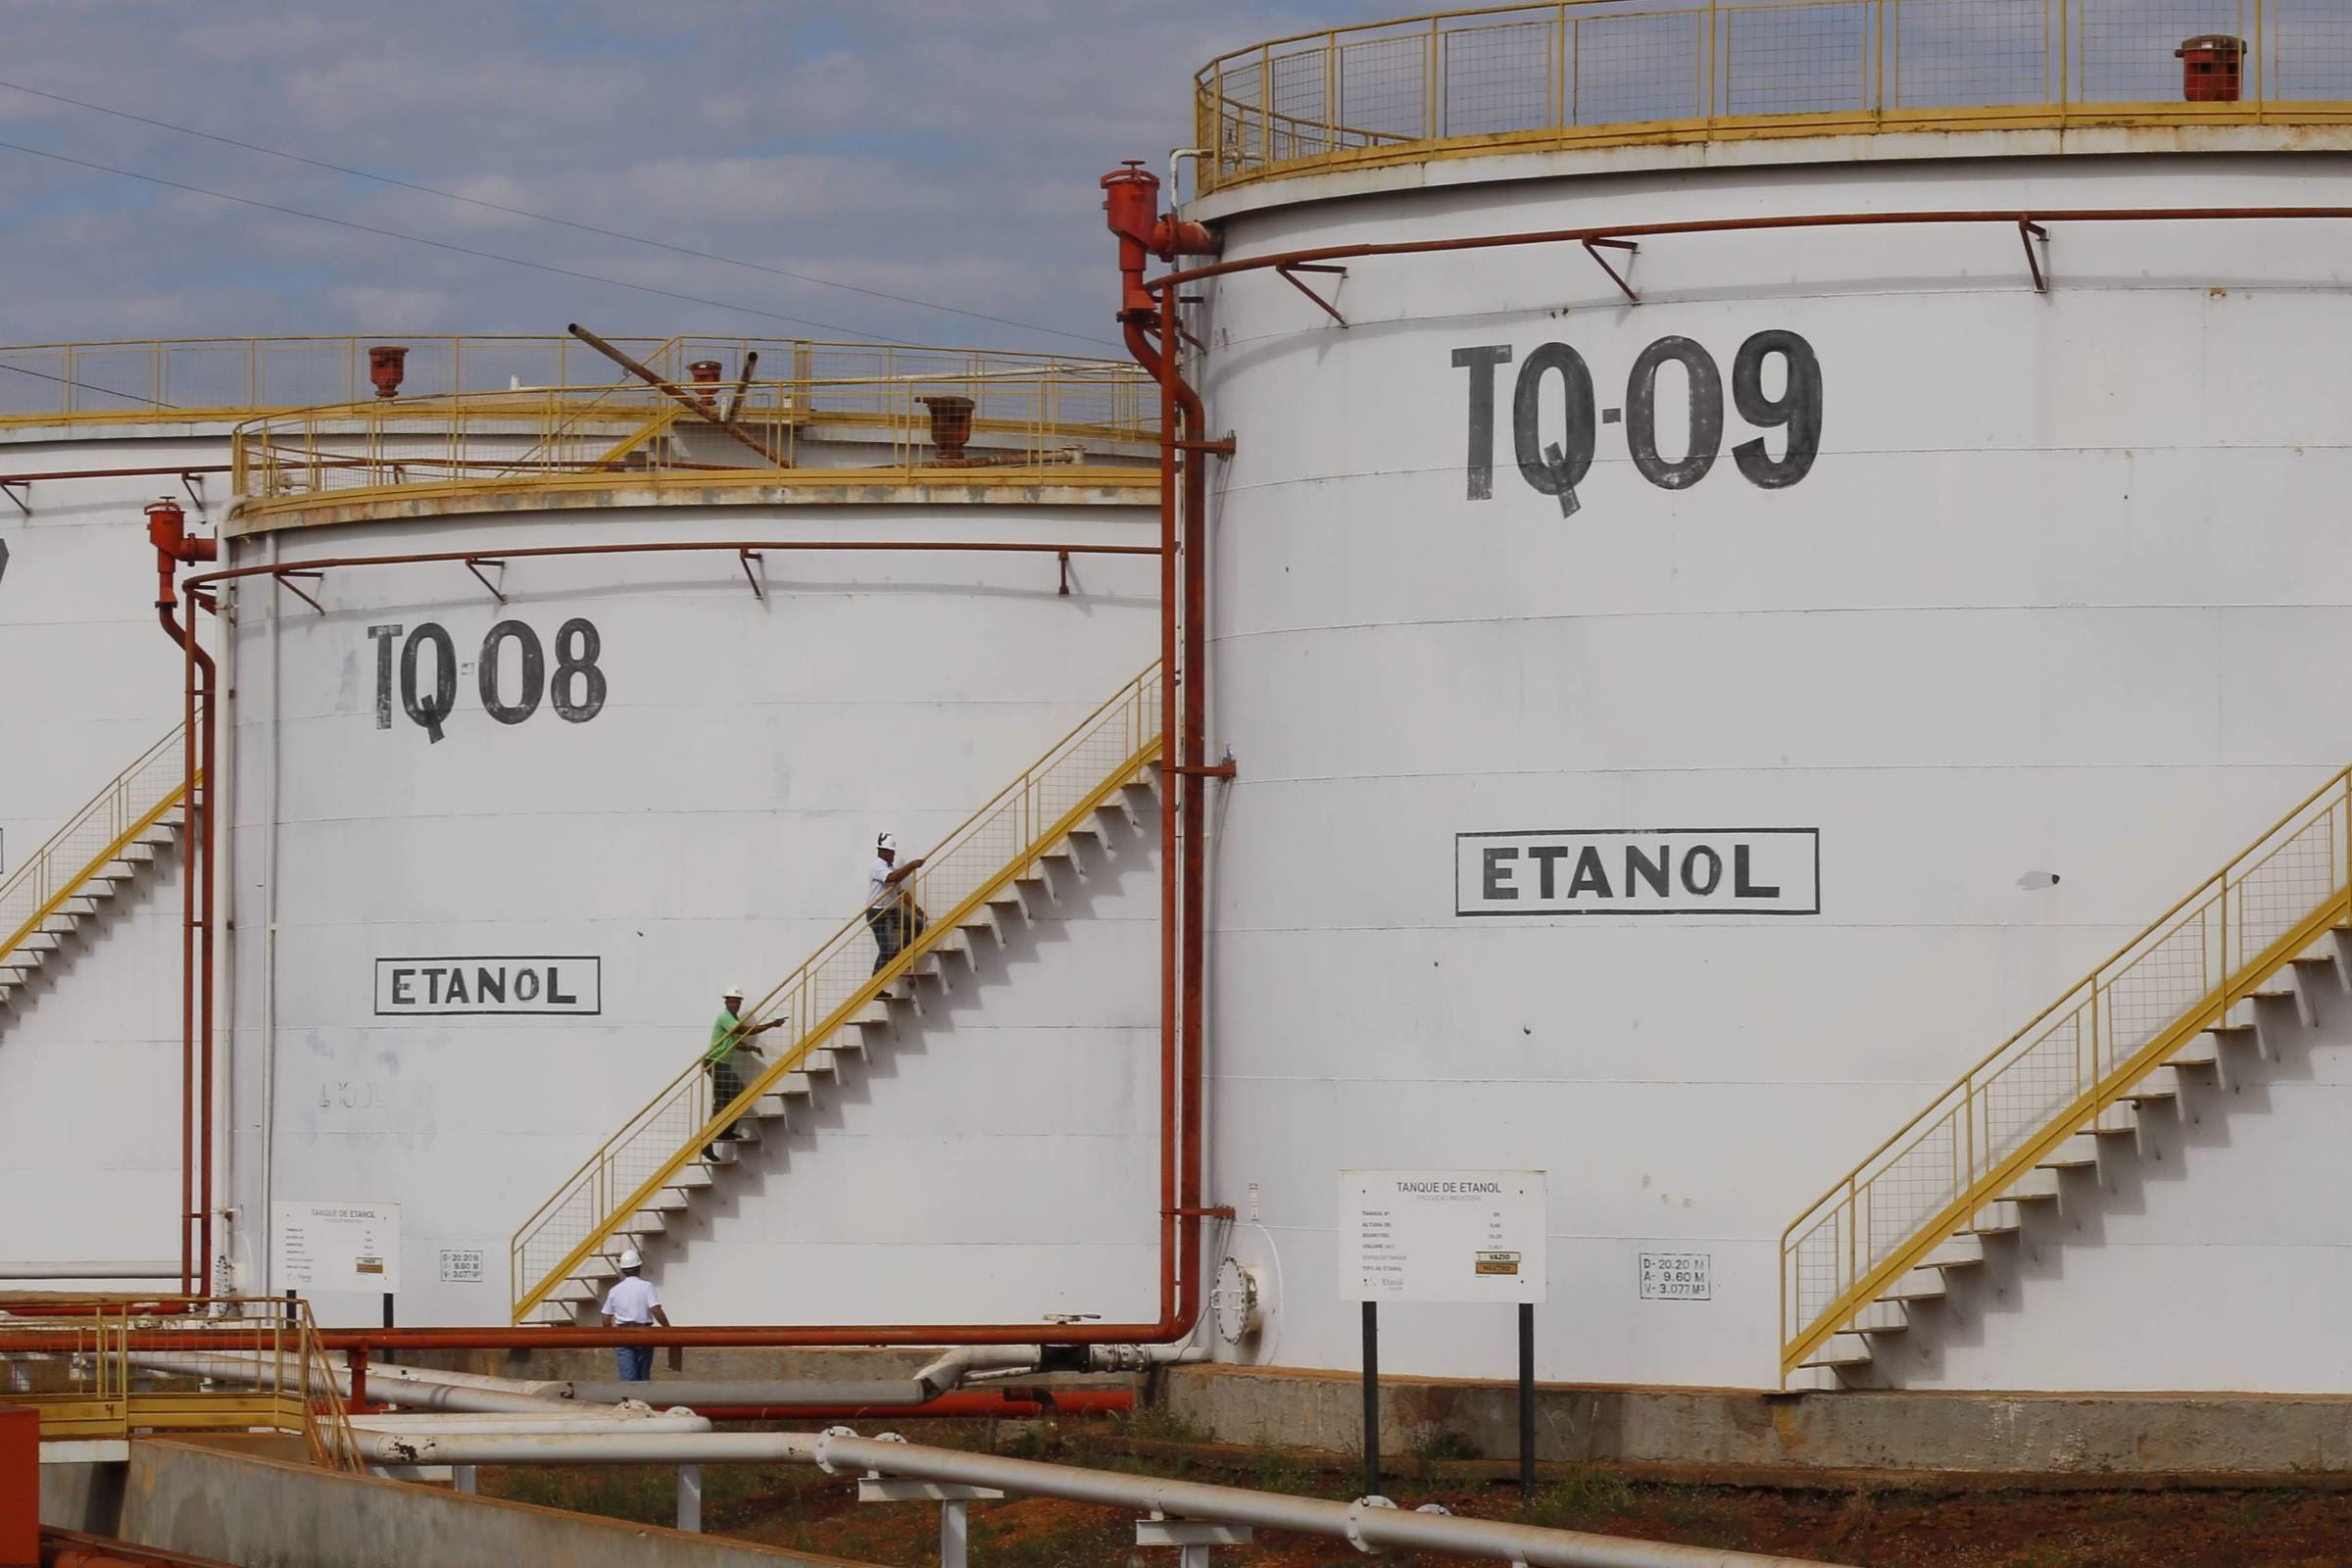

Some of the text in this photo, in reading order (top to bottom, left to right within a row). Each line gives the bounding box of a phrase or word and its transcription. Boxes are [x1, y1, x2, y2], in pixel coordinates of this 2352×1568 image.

[1451, 328, 1823, 519] TQ-09
[367, 618, 607, 745] TQ-08
[1483, 844, 1781, 900] ETANOL
[391, 965, 577, 1005] ETANOL
[1396, 1181, 1502, 1195] TANQUE DE ETANOL
[1643, 1258, 1656, 1268] D-
[1643, 1270, 1656, 1281] A-
[1663, 1271, 1691, 1281] 9.60
[1658, 1283, 1690, 1294] 3.077
